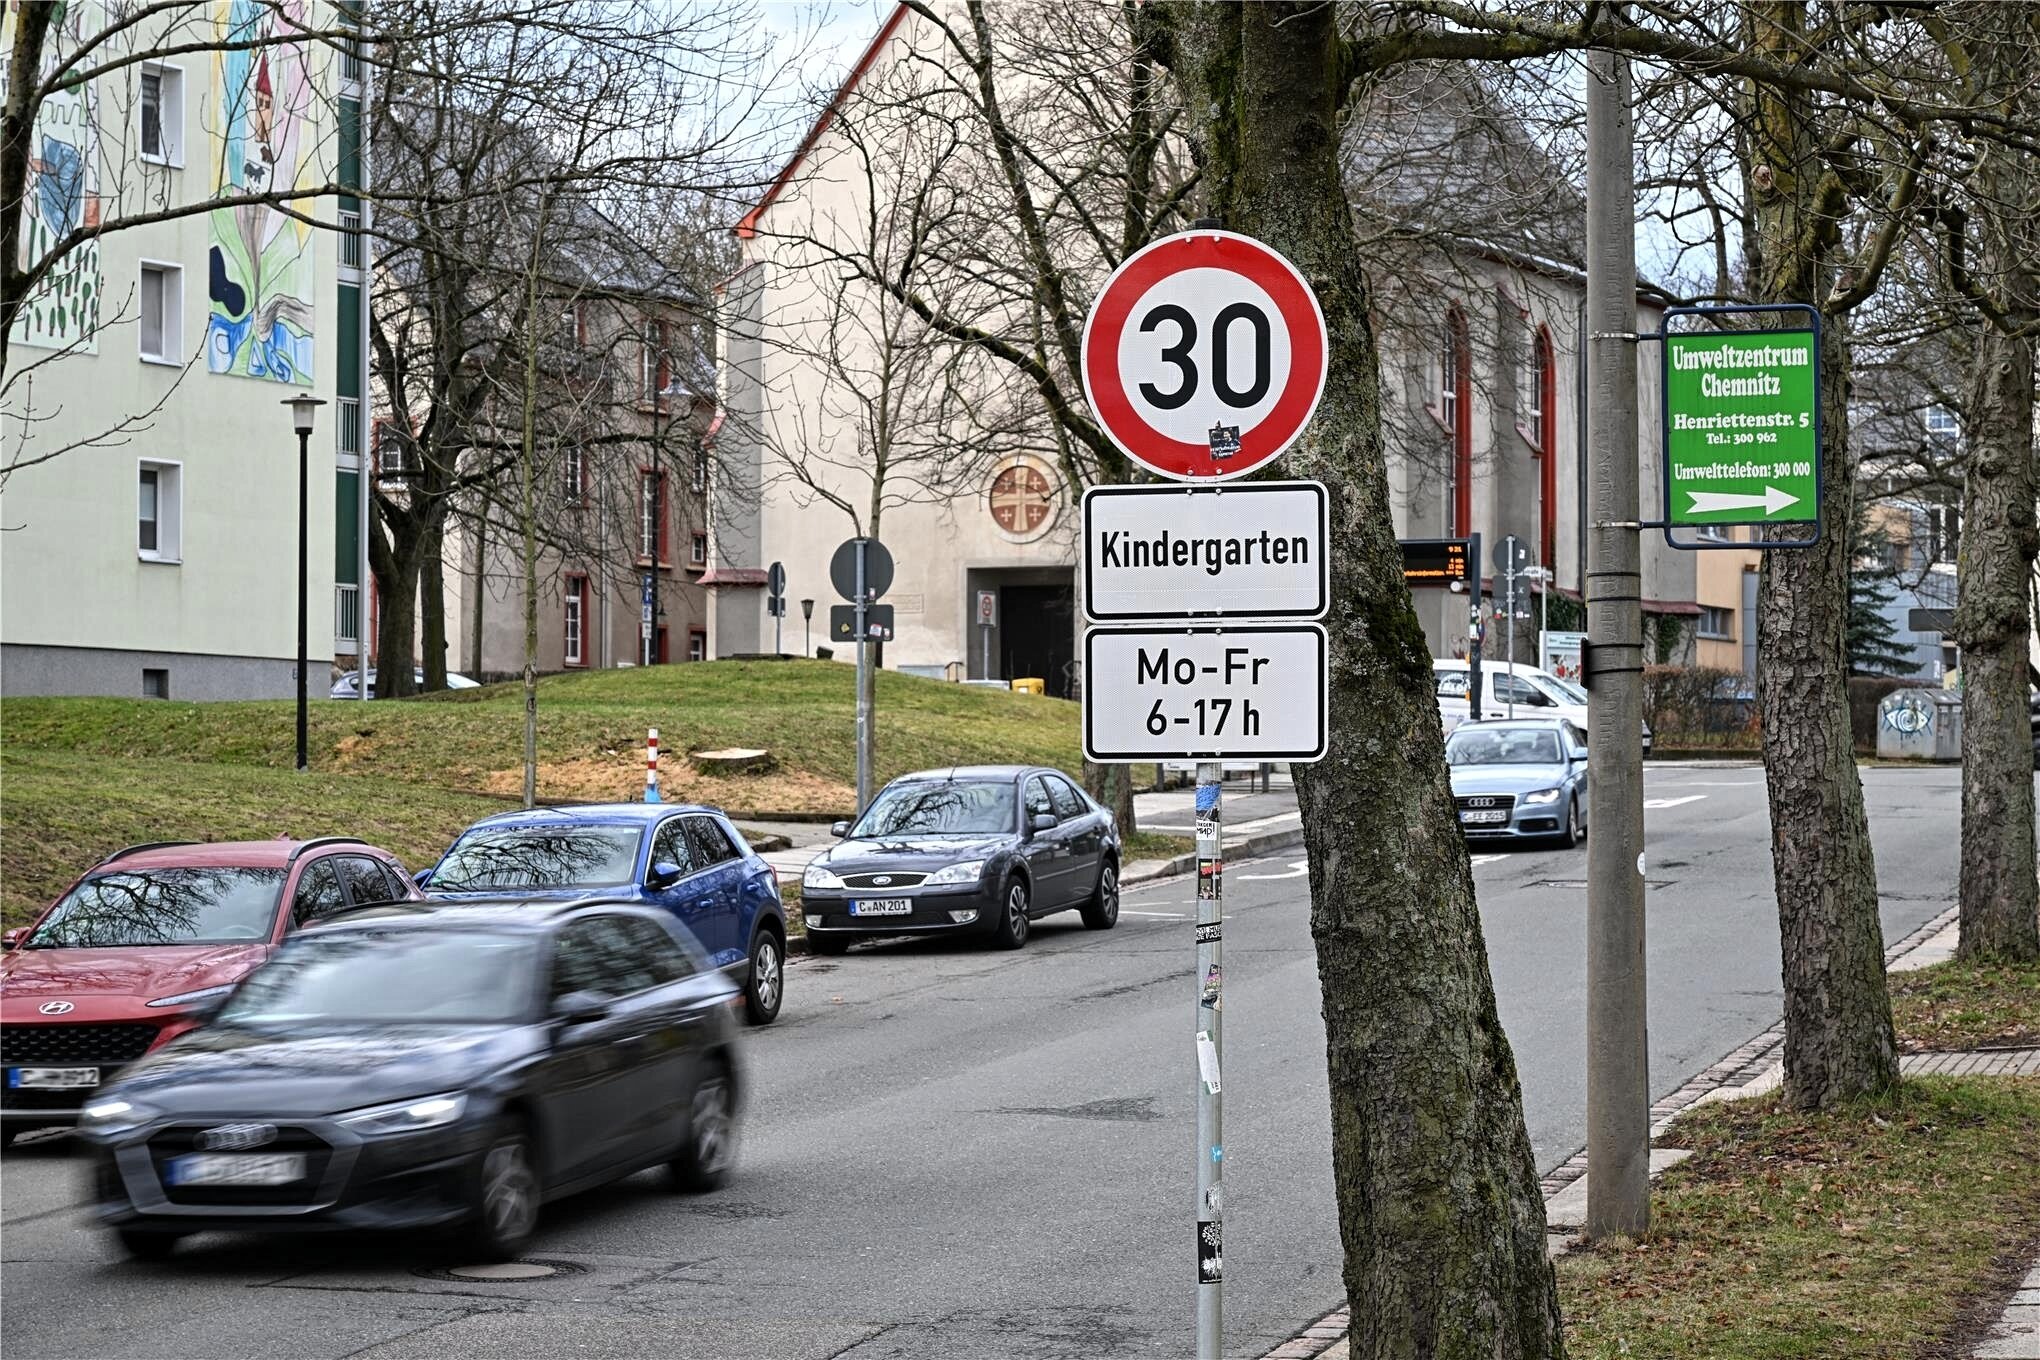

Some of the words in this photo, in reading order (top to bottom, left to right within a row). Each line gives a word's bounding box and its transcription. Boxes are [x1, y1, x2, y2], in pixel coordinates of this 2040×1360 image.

[1139, 302, 1271, 410] 30
[1672, 344, 1809, 370] Umweltzentrum
[1701, 371, 1781, 397] Chemnitz
[1673, 411, 1795, 430] Henriettenstr.
[1798, 412, 1810, 428] 5
[1705, 432, 1731, 445] Tel.:
[1733, 433, 1754, 445] 300
[1756, 432, 1778, 444] 962
[1674, 461, 1771, 480] Umwelttelefon:
[1773, 462, 1791, 479] 300
[1792, 461, 1811, 477] 000
[1101, 530, 1309, 576] Kindergarten
[1137, 648, 1270, 685] Mo-Fr
[1146, 699, 1232, 736] 6-17
[1243, 699, 1260, 736] h
[859, 901, 866, 912] C
[872, 901, 886, 911] AN
[887, 900, 907, 911] 201
